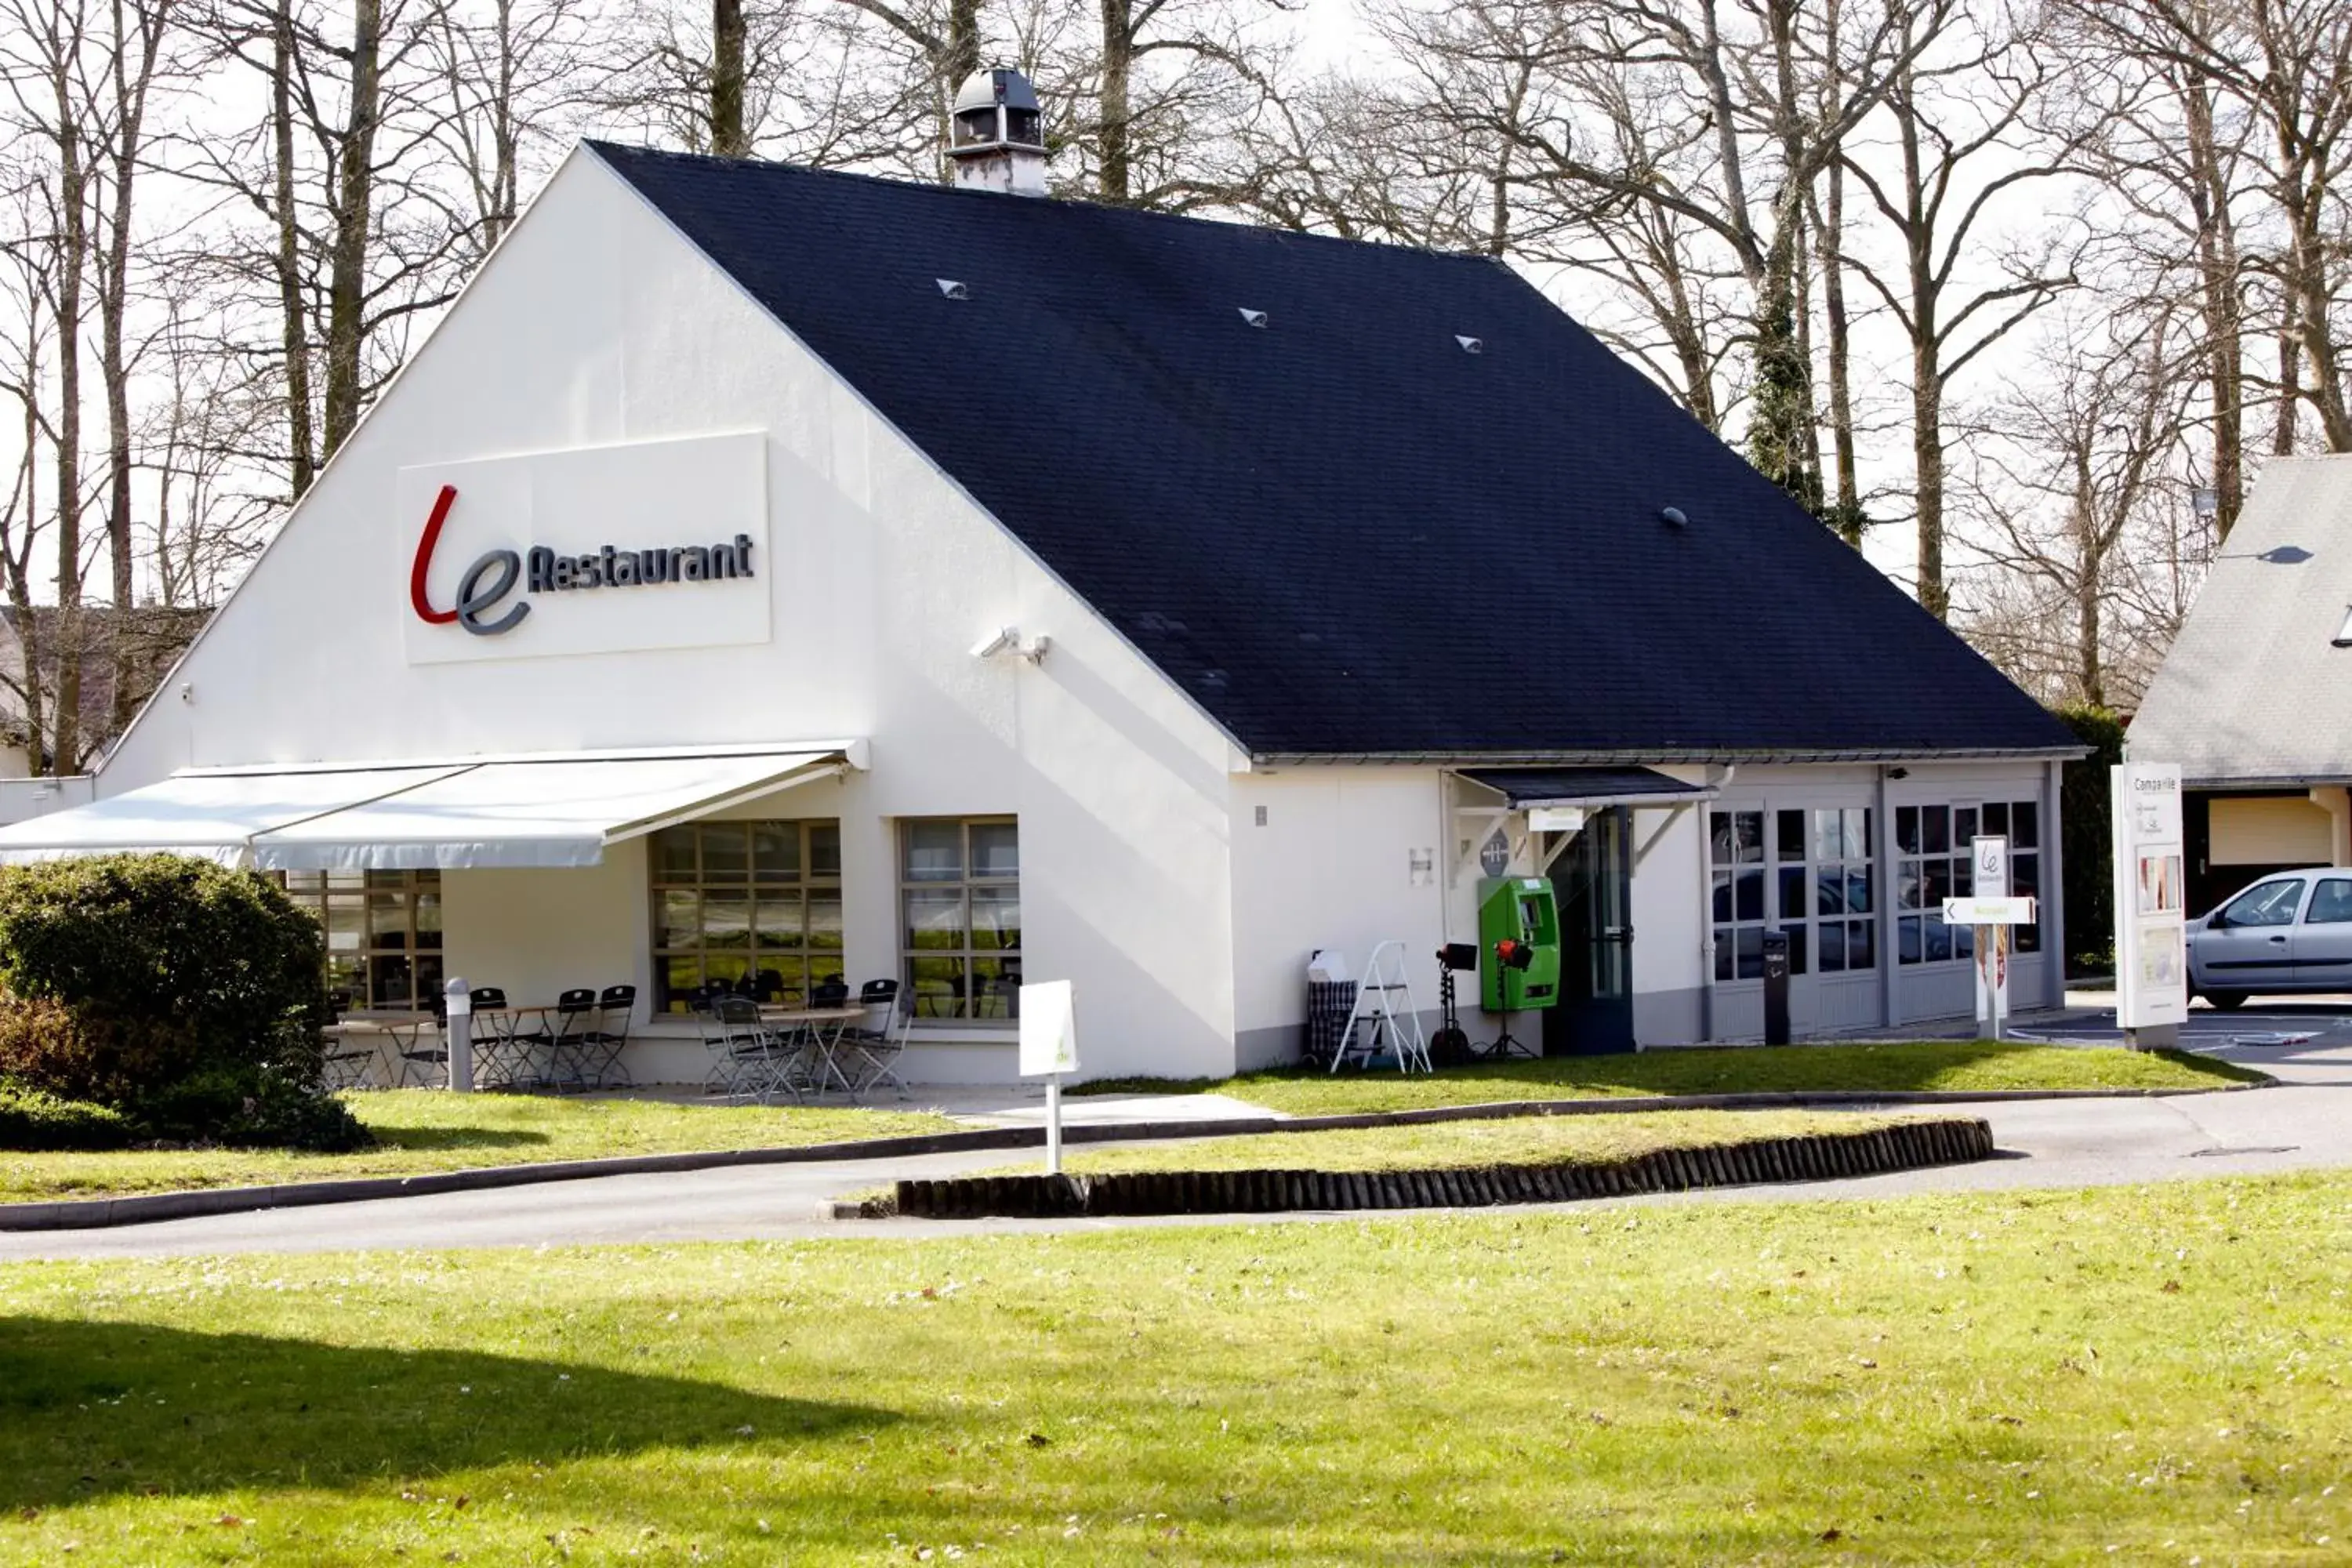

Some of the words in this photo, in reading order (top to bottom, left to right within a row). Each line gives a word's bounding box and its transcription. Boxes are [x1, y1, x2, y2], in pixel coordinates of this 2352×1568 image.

[410, 484, 532, 635] Le
[527, 533, 754, 593] Restaurant
[2133, 777, 2176, 791] Campaile
